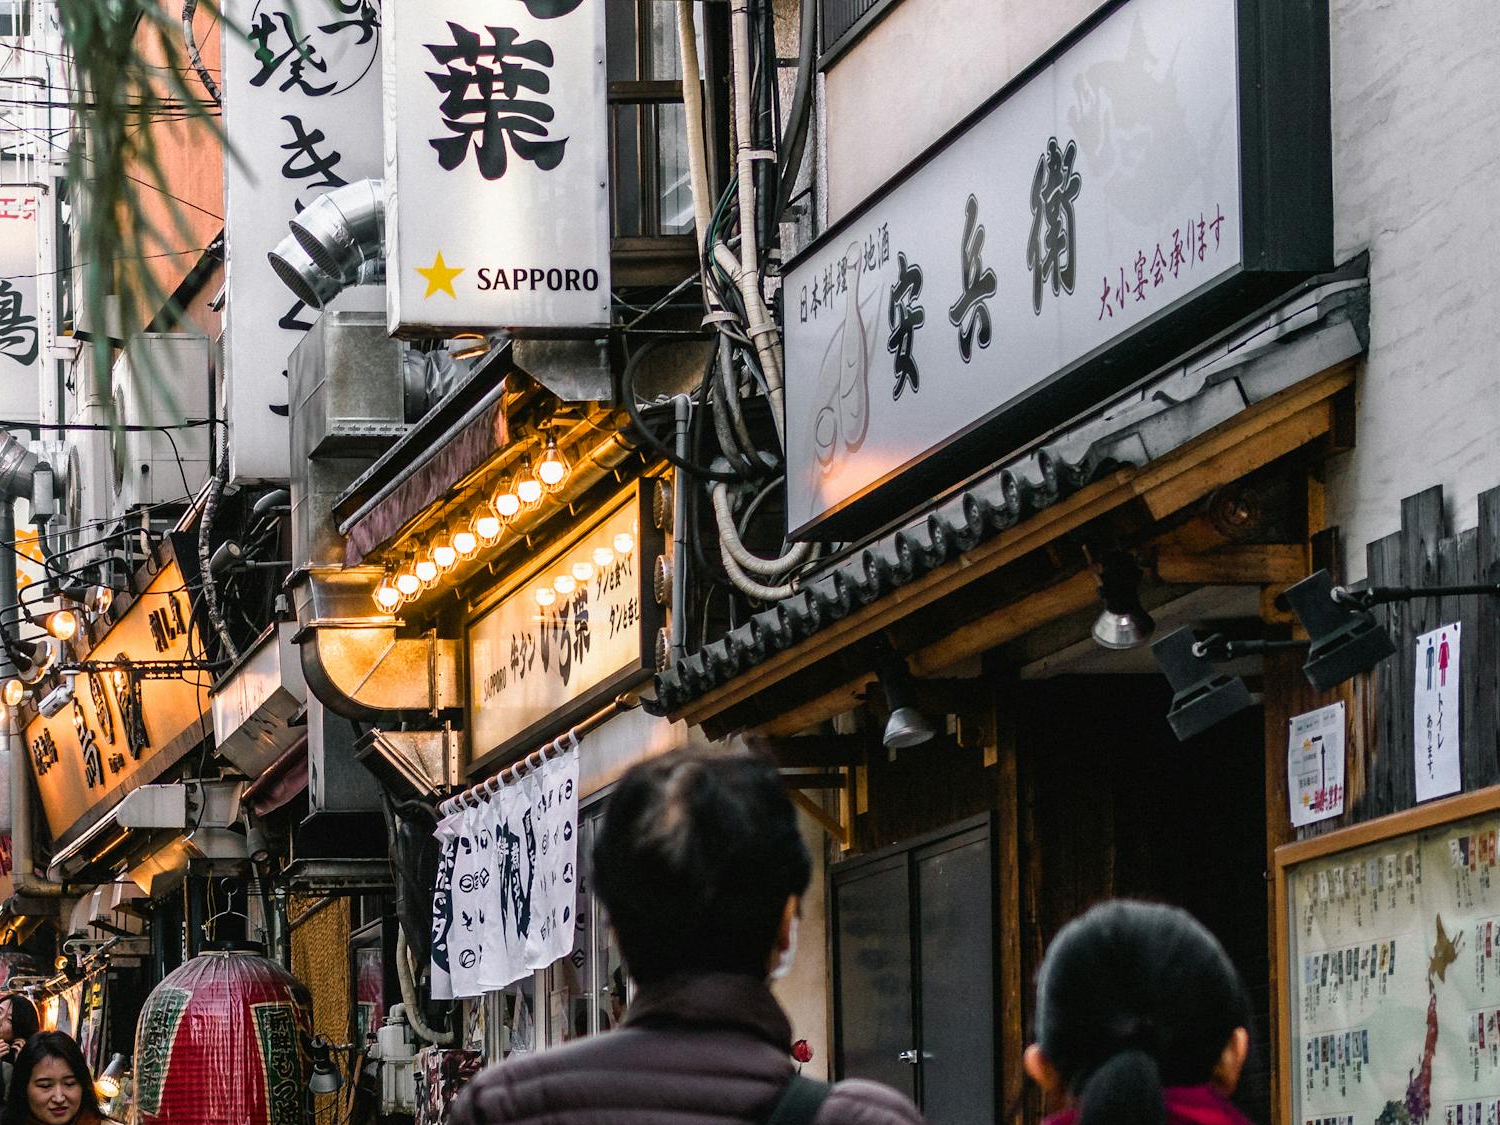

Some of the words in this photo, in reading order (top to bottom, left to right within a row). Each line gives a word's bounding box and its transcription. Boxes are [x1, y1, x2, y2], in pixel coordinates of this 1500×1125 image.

[422, 0, 585, 181] 葉
[477, 267, 599, 292] SAPPORO
[799, 256, 848, 325] 日本料理
[862, 221, 891, 274] 地酒
[887, 135, 1083, 401] 安兵衛
[1098, 203, 1226, 322] 大小宴会承ります
[484, 666, 507, 703] SAPPORO
[510, 631, 536, 684] 牛タン
[1437, 692, 1445, 751] トイレ
